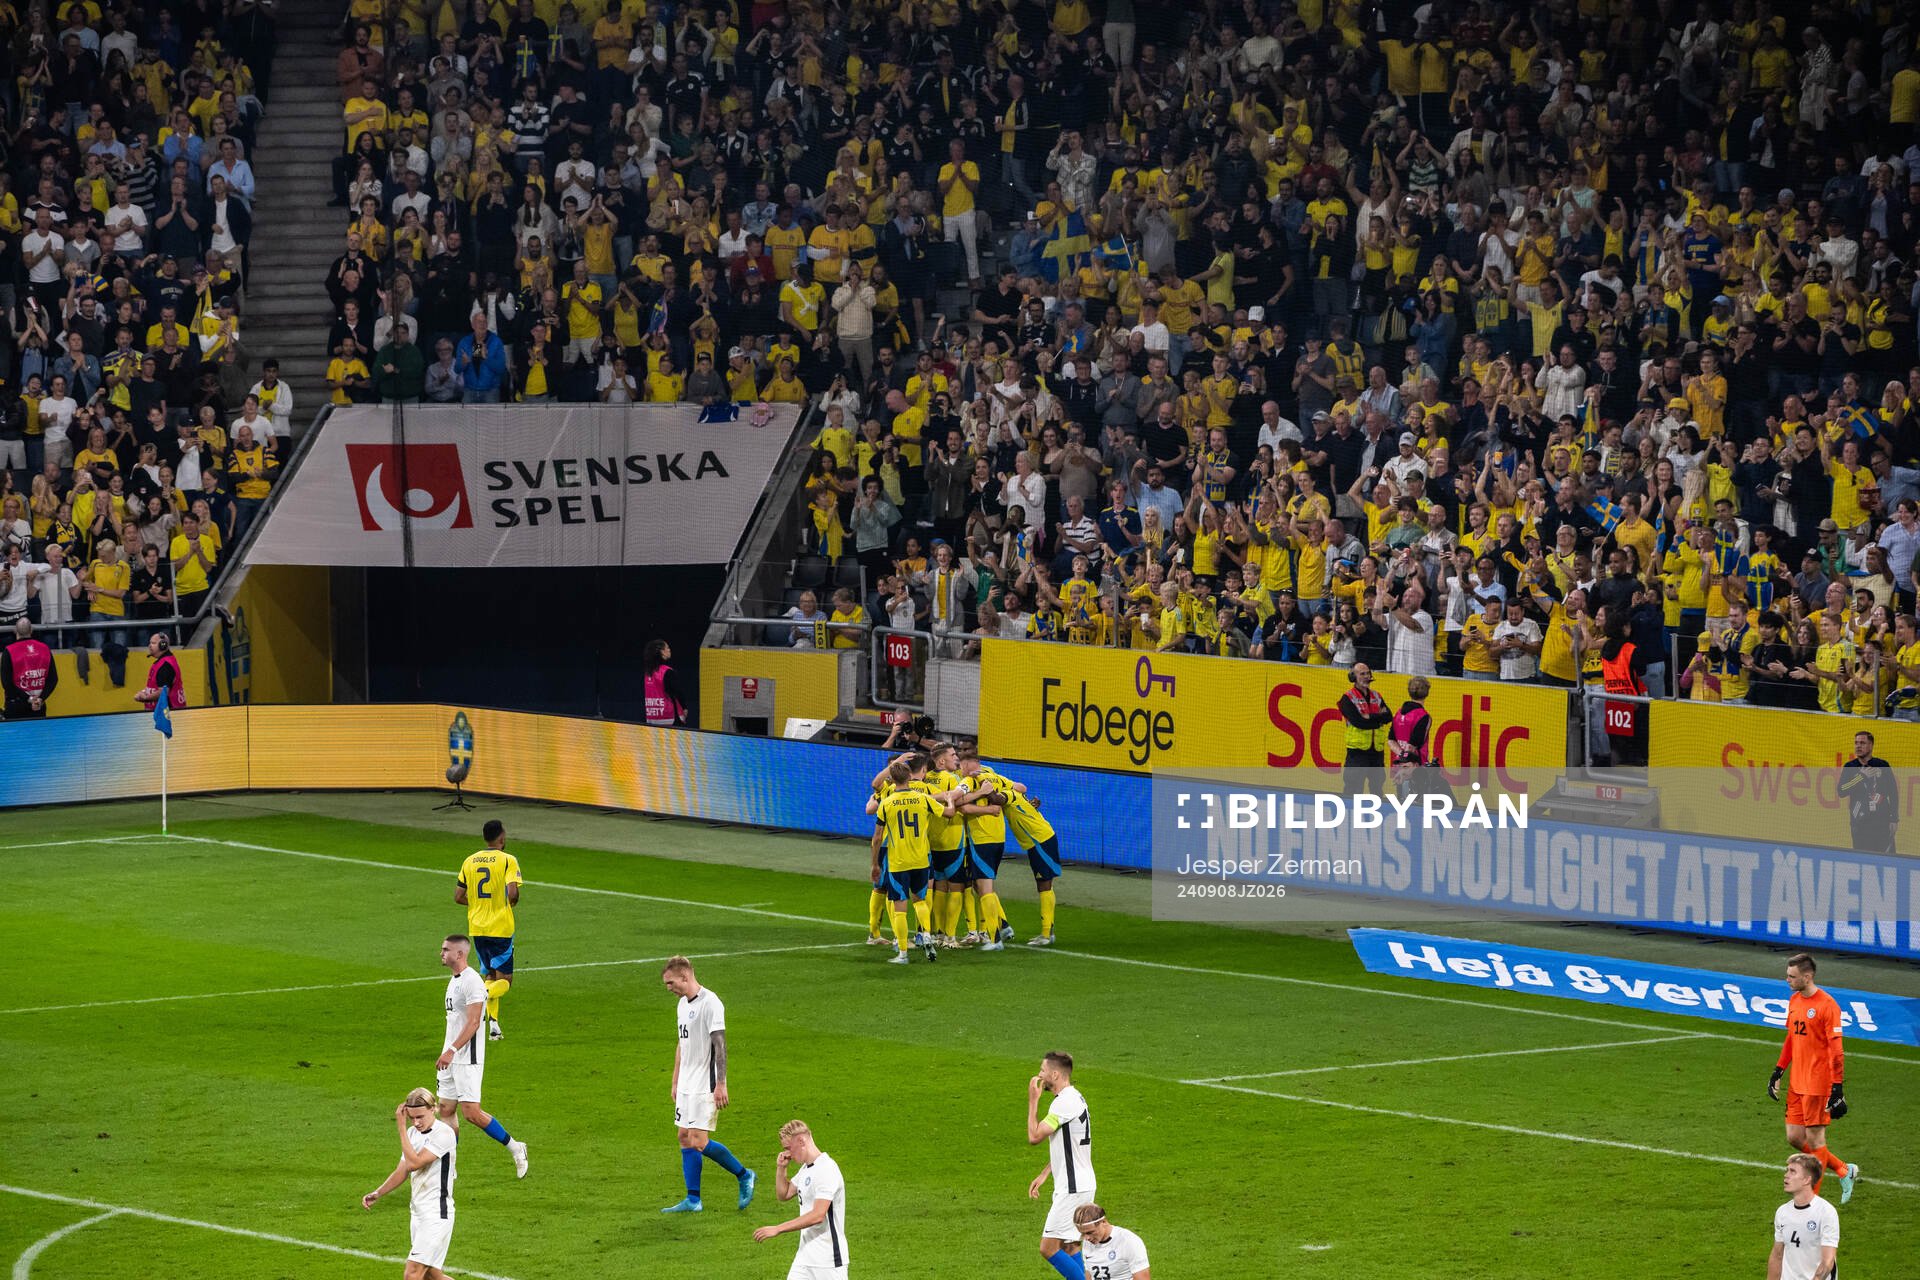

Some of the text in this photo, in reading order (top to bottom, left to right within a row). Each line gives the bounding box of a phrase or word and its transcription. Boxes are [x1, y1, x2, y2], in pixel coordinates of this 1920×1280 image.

[483, 450, 730, 491] SVENSKA
[491, 494, 620, 528] SPEL
[889, 643, 910, 660] 103
[1042, 677, 1175, 766] Fabege
[1607, 709, 1632, 729] 102
[1267, 682, 1530, 794] Scdic
[1601, 787, 1617, 799] 102
[1720, 742, 1920, 817] Swed
[896, 808, 919, 839] 14
[476, 866, 492, 899] 2
[1279, 800, 1412, 892] FINNS
[1421, 814, 1666, 921] MÖJLIGHET
[1672, 845, 1760, 931] ATT
[1766, 848, 1898, 949] ÄVEN
[1387, 941, 1879, 1032] Heja Sverig!
[679, 1024, 689, 1039] 16
[1794, 1019, 1808, 1036] 12
[1790, 1229, 1801, 1248] 4
[1092, 1265, 1111, 1280] 23
